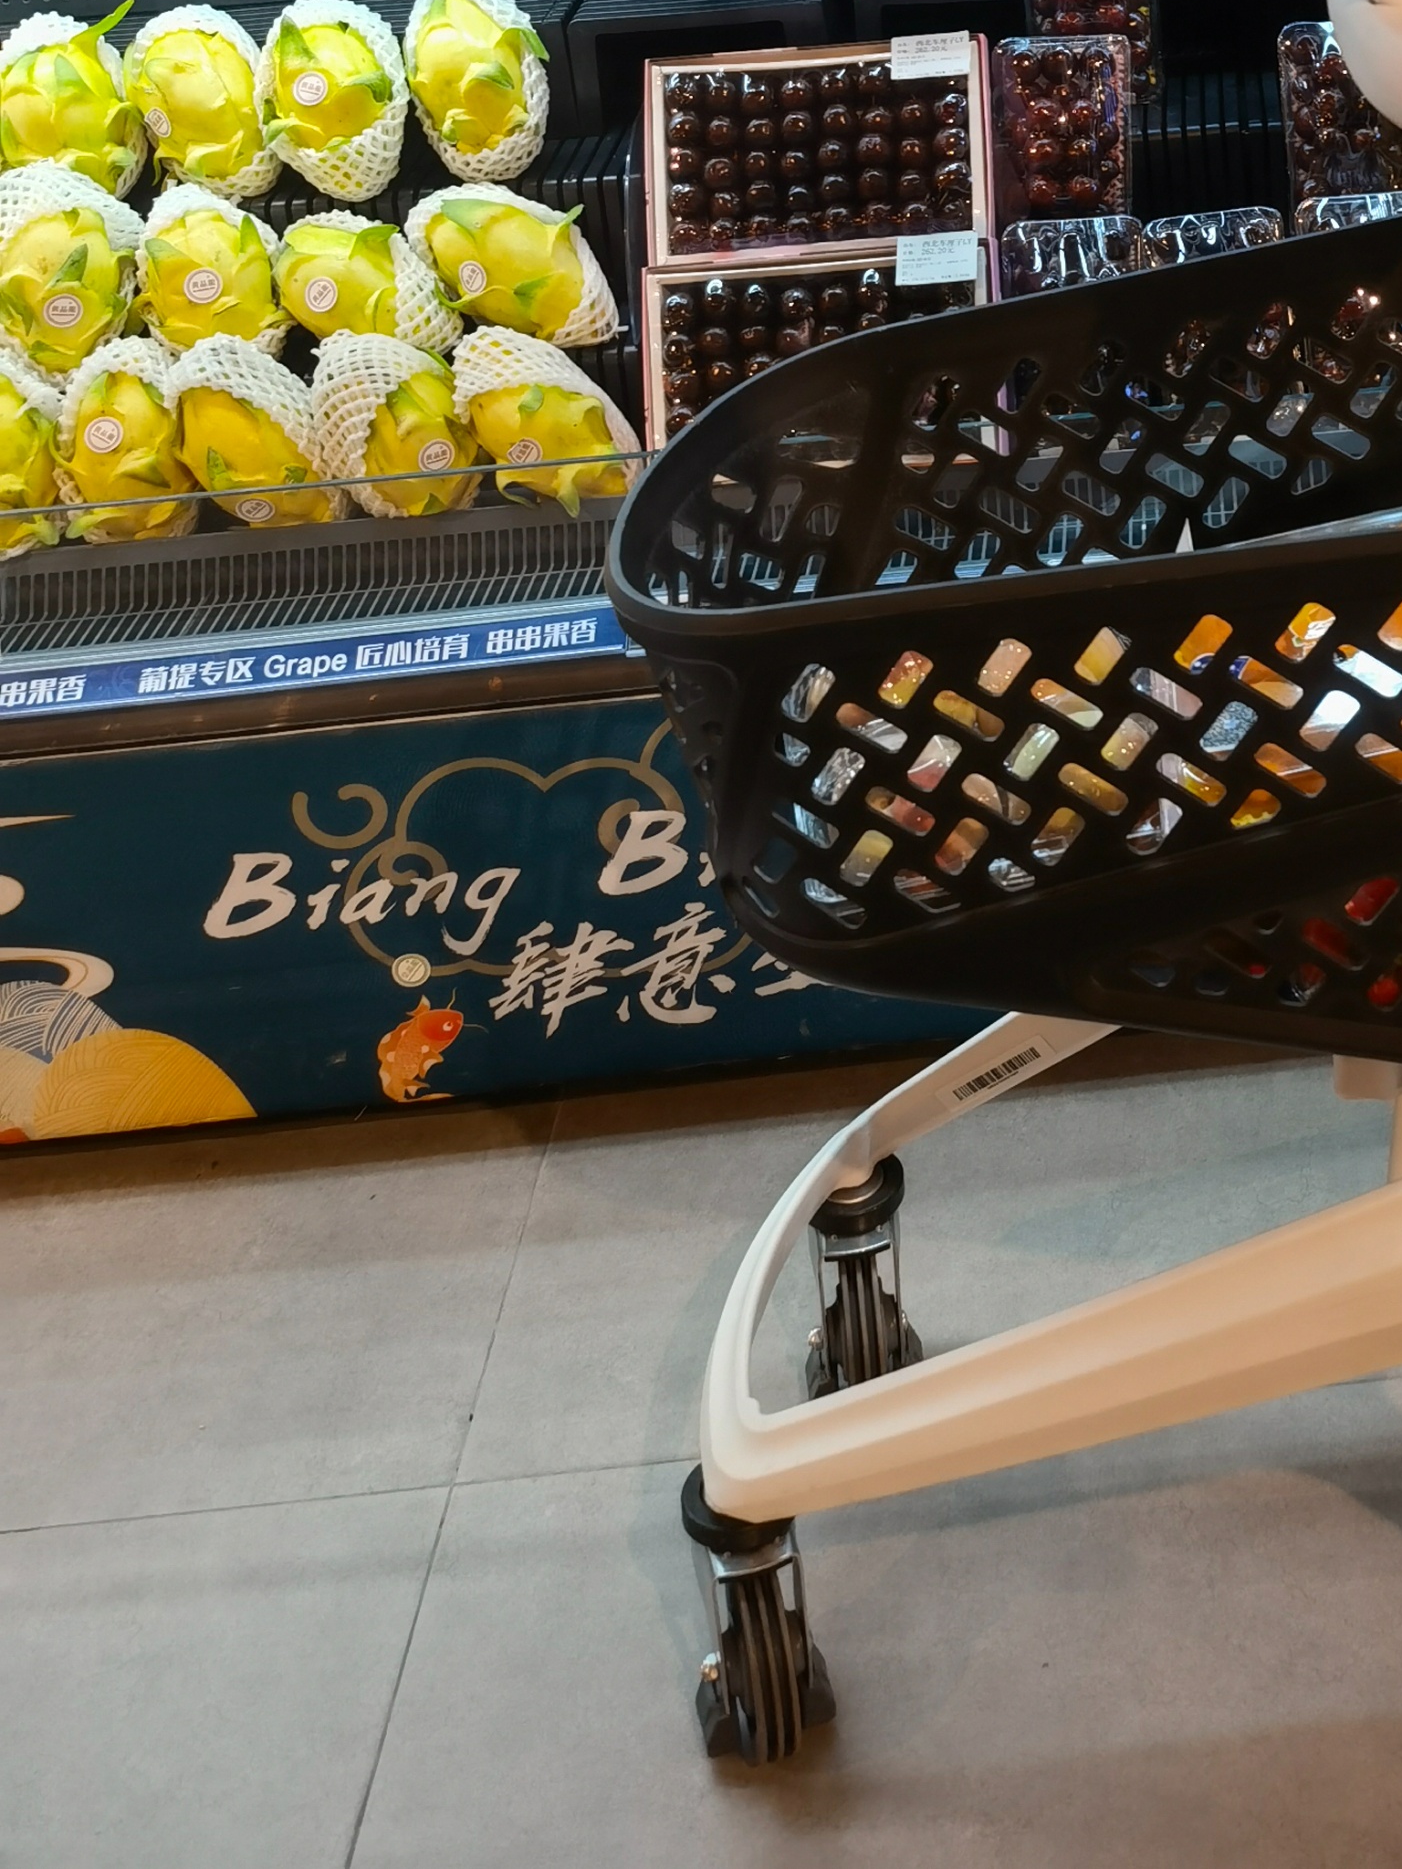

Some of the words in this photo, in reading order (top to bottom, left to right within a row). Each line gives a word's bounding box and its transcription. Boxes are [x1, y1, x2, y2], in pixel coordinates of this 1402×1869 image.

[264, 648, 347, 684] Grape
[356, 635, 469, 672] 匠心培育
[486, 619, 598, 657] 串串果香
[203, 851, 519, 954] Biang
